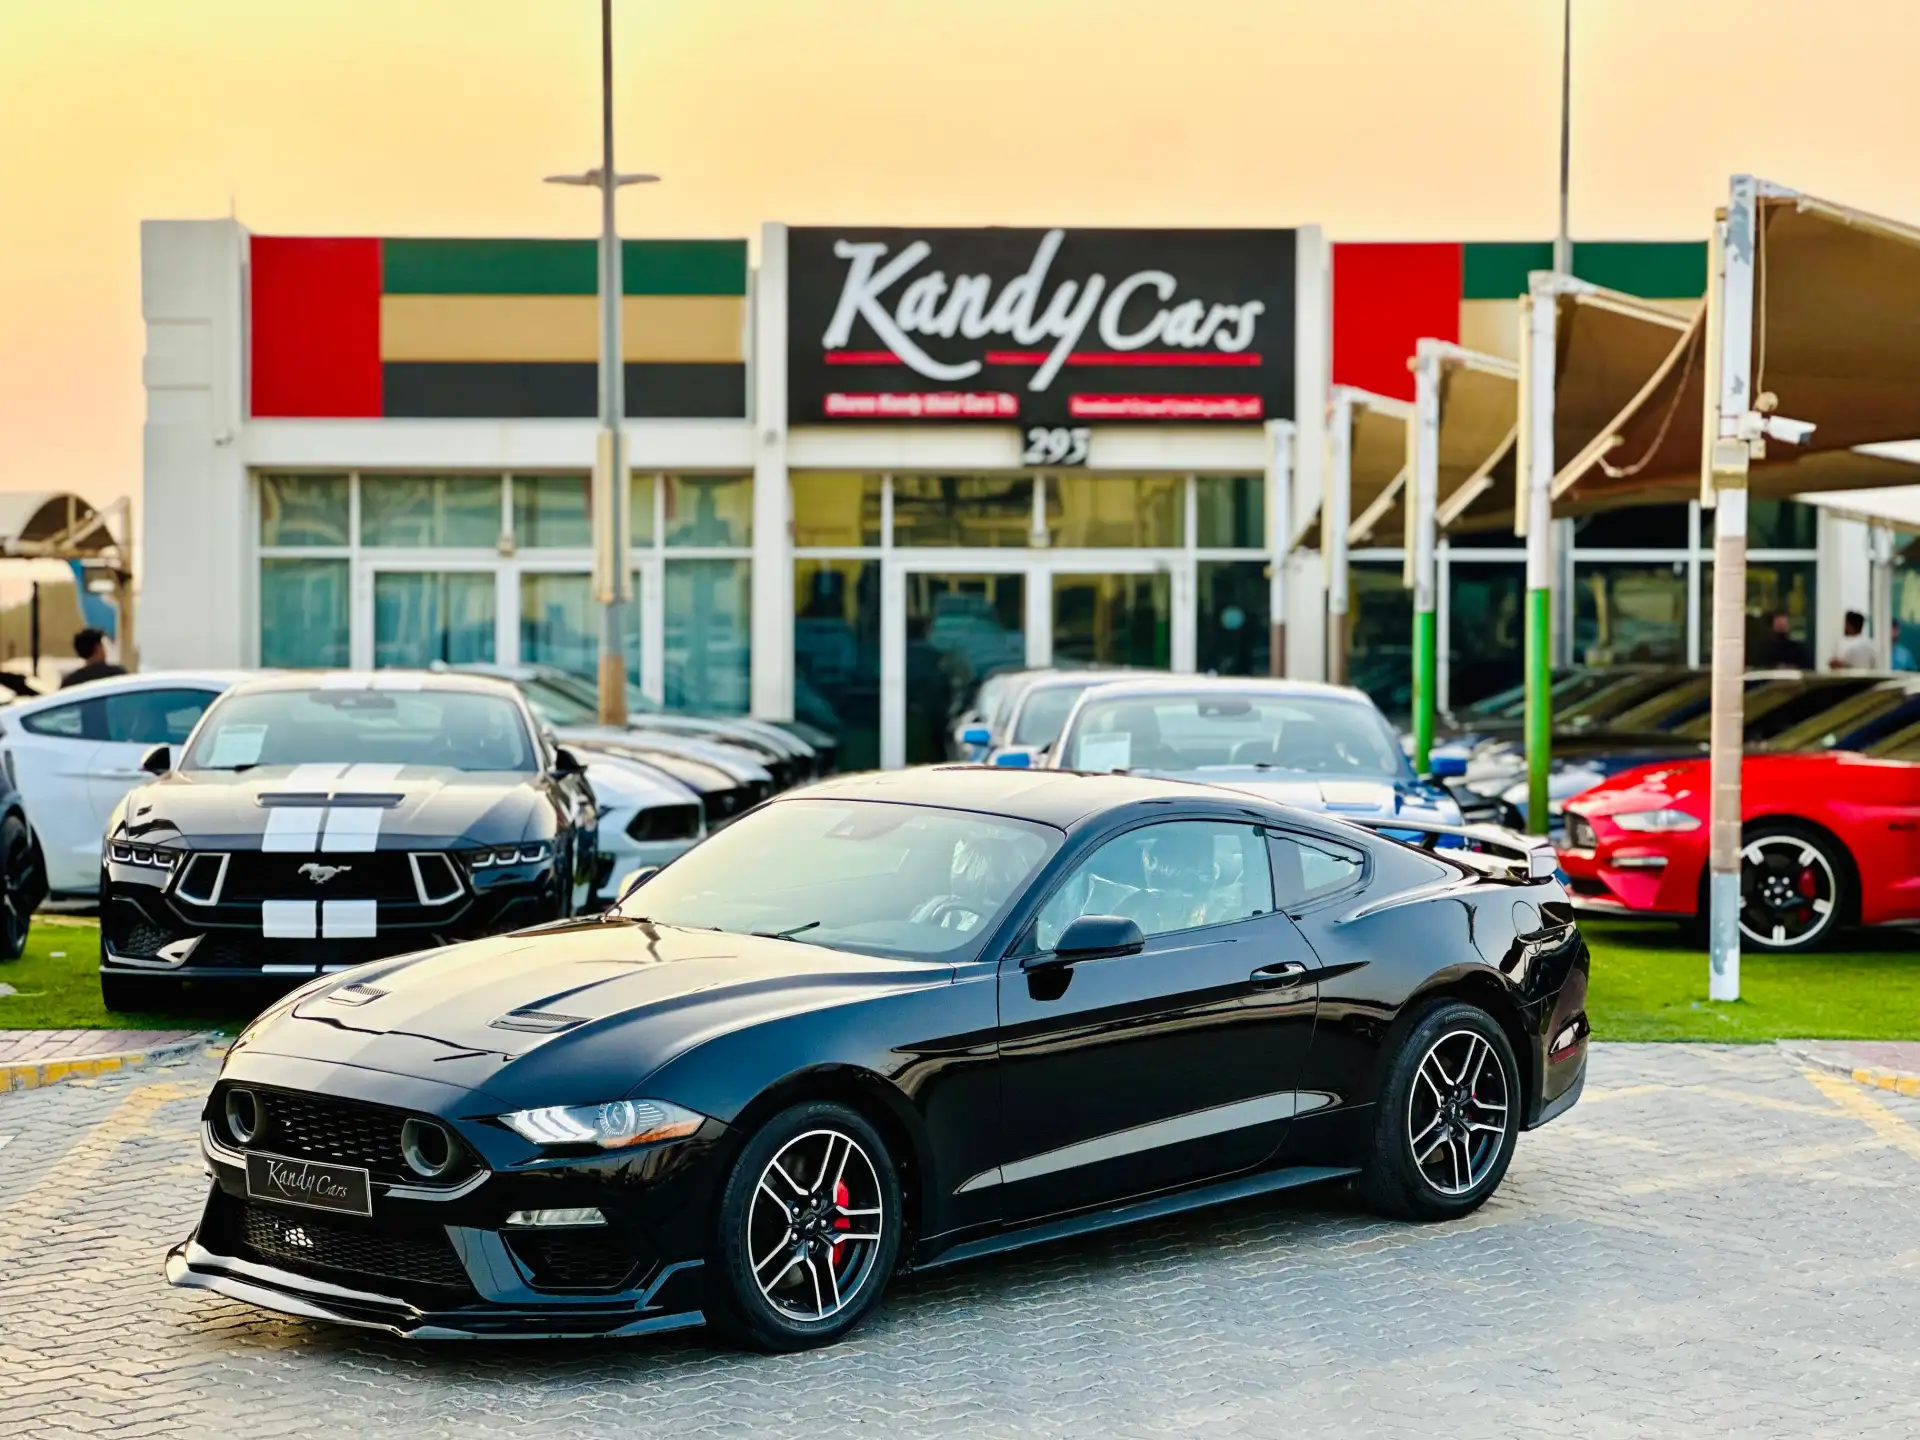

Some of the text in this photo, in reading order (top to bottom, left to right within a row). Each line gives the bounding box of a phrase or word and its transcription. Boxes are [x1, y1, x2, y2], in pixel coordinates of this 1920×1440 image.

[822, 228, 1265, 391] Kandy Cars
[1023, 427, 1091, 464] 295
[267, 1160, 348, 1203] Kandy Cars
